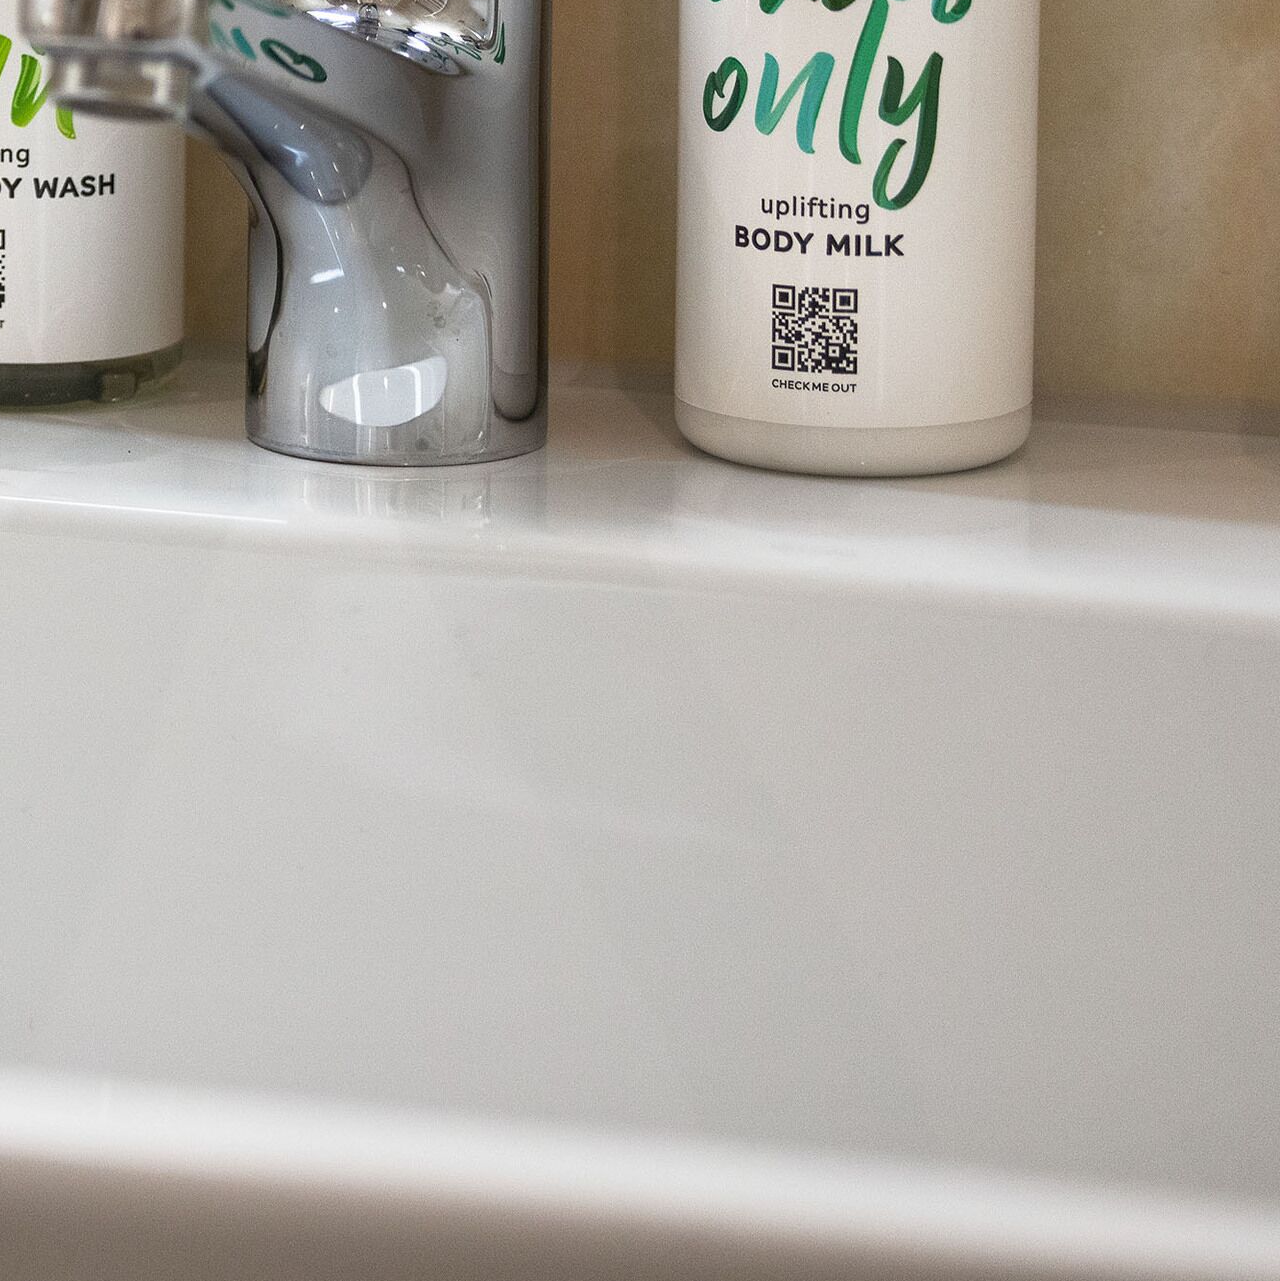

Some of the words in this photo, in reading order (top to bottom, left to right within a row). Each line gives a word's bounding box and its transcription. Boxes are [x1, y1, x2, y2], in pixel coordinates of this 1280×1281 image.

[33, 172, 116, 199] WASH
[760, 194, 870, 225] uplifting
[734, 224, 815, 256] BODY
[826, 232, 905, 257] MILK
[831, 383, 857, 393] OUT
